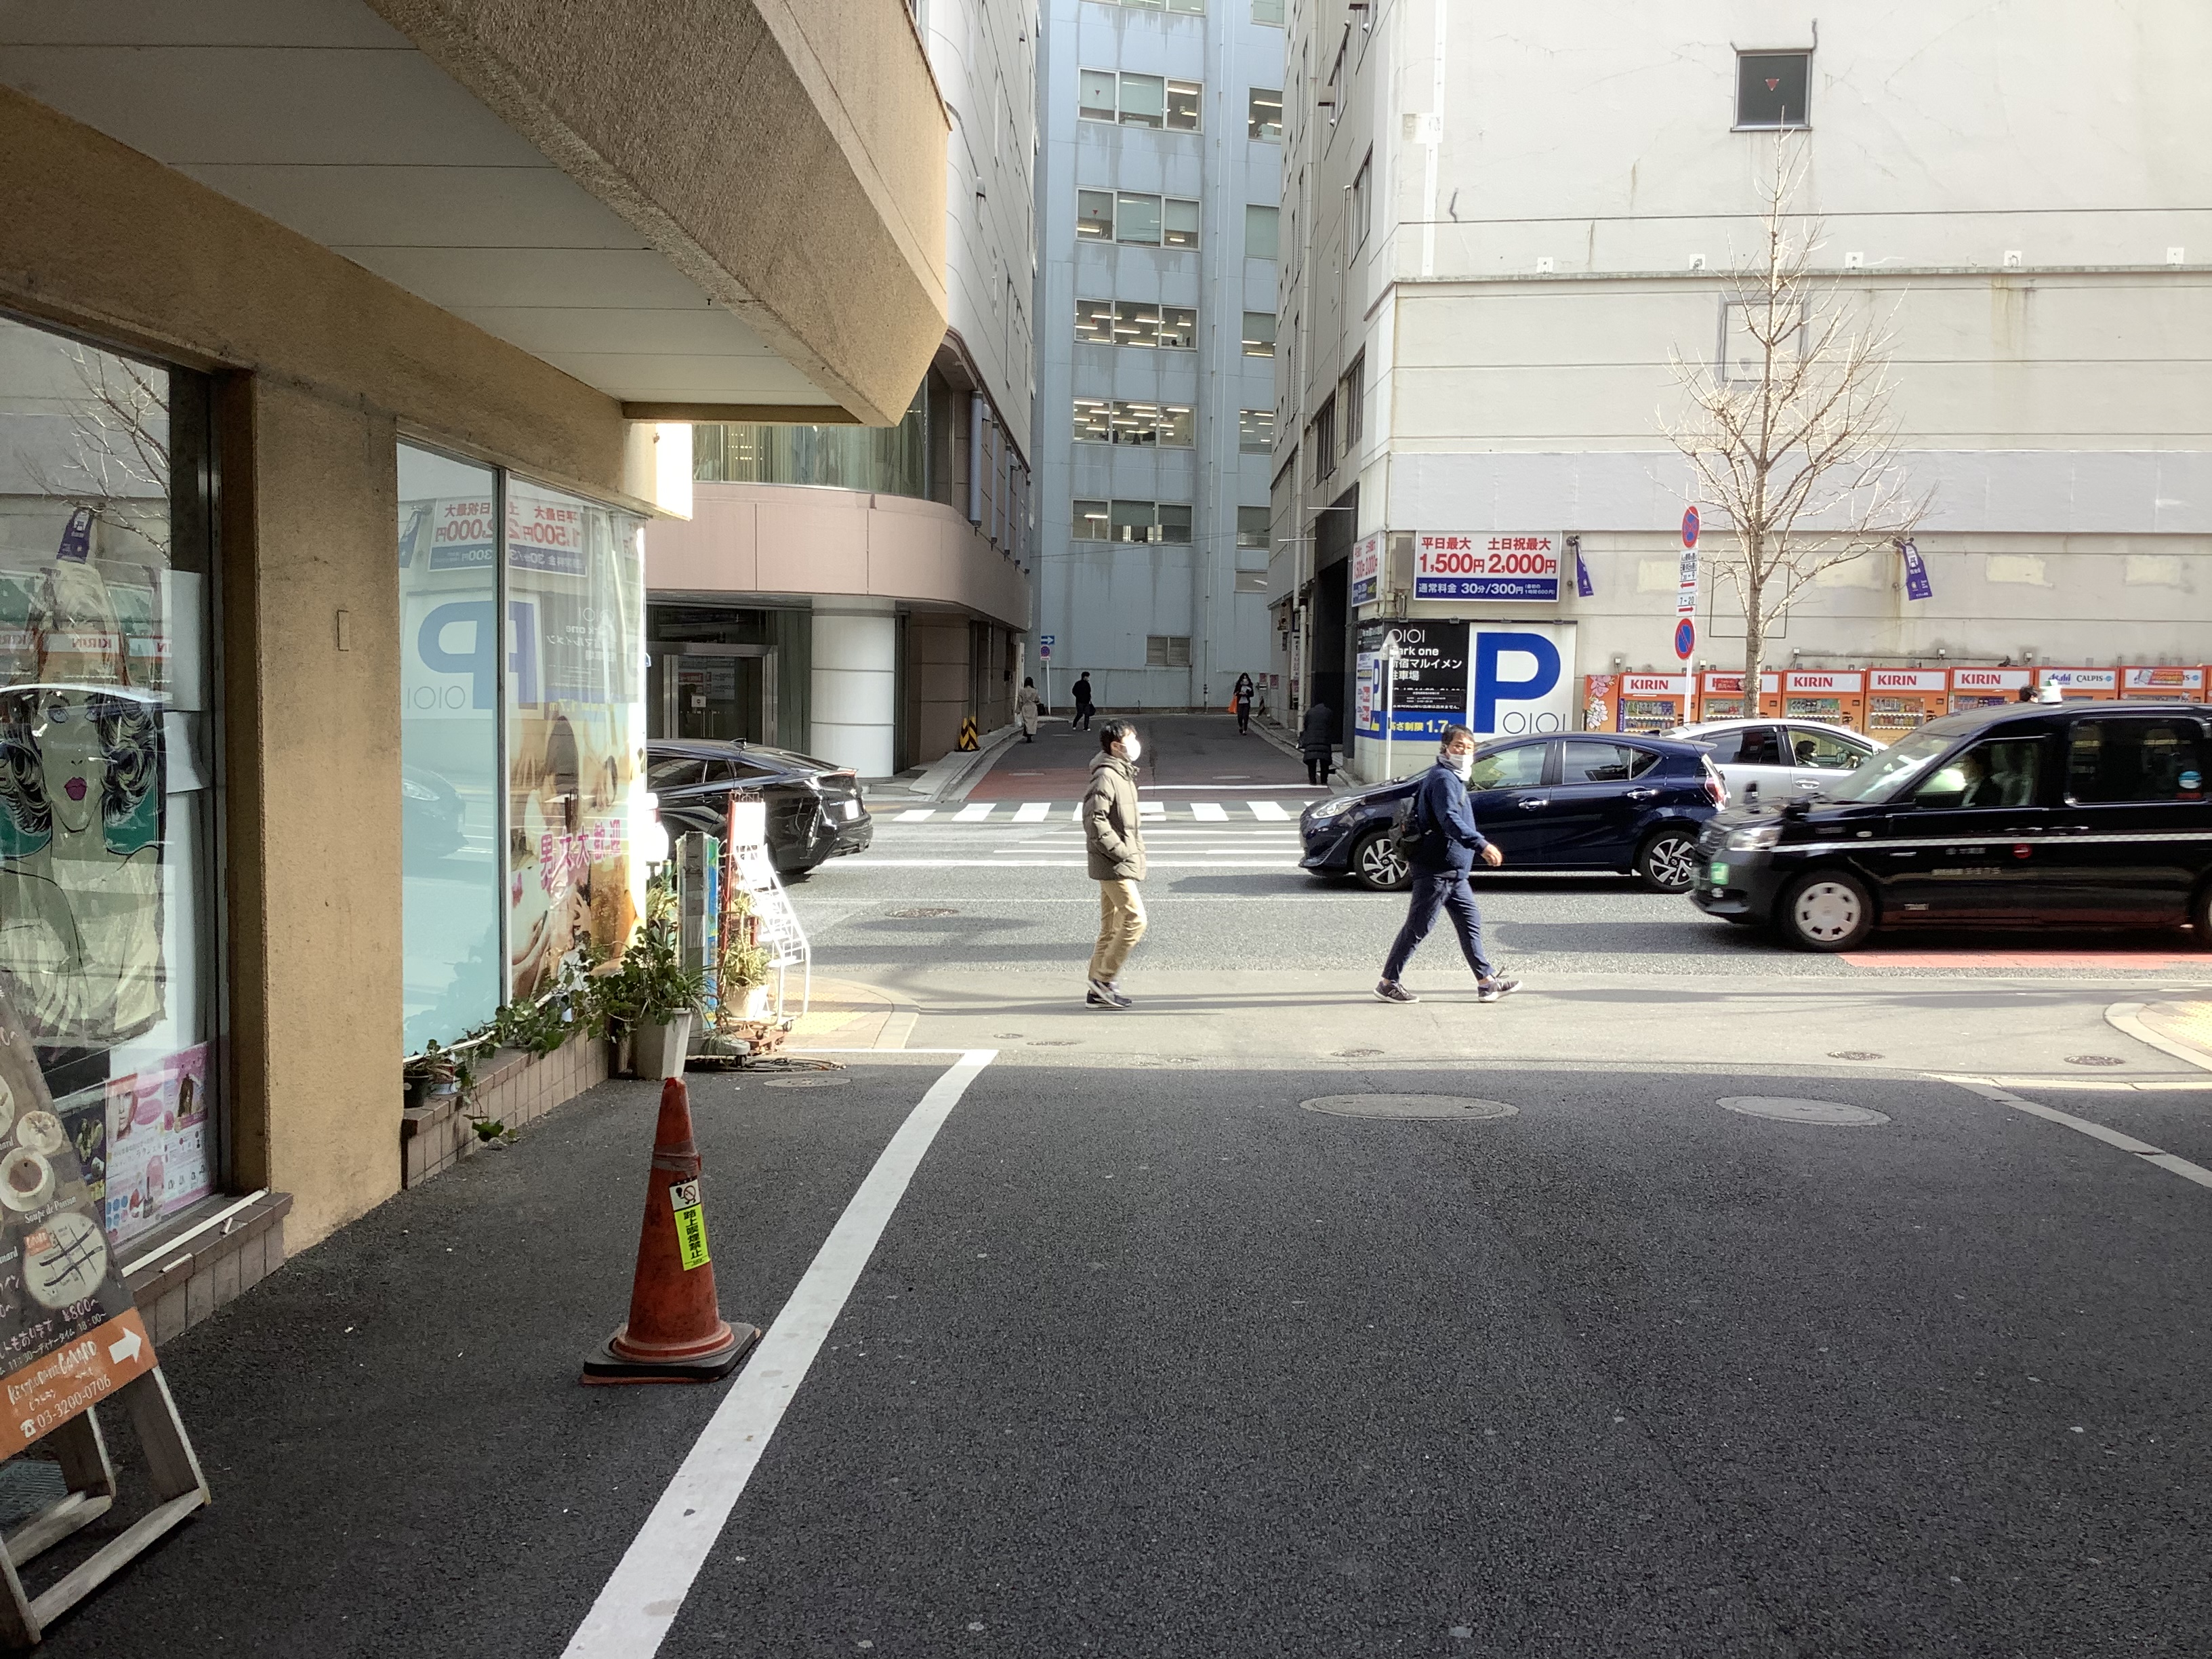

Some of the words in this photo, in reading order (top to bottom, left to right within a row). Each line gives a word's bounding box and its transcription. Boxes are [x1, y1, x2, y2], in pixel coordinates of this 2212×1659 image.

[1422, 537, 1471, 550] 平日最大
[1488, 537, 1551, 550] 土日祝最大
[1420, 553, 1485, 573] 1,500円
[1488, 554, 1557, 574] 2,000円
[1418, 583, 1456, 594] 通常料金
[1461, 583, 1523, 594] 30分/300円
[1399, 646, 1416, 655] ark
[1418, 648, 1439, 656] one
[1473, 632, 1561, 733] P
[1631, 679, 1668, 690] KIRIN
[1794, 676, 1833, 687] KIRIN
[1877, 674, 1917, 685] KIRIN
[1961, 674, 2001, 684] KIRIN
[684, 1209, 703, 1259] 路上喫煙禁止
[37, 1374, 111, 1428] 03-3200-0706
